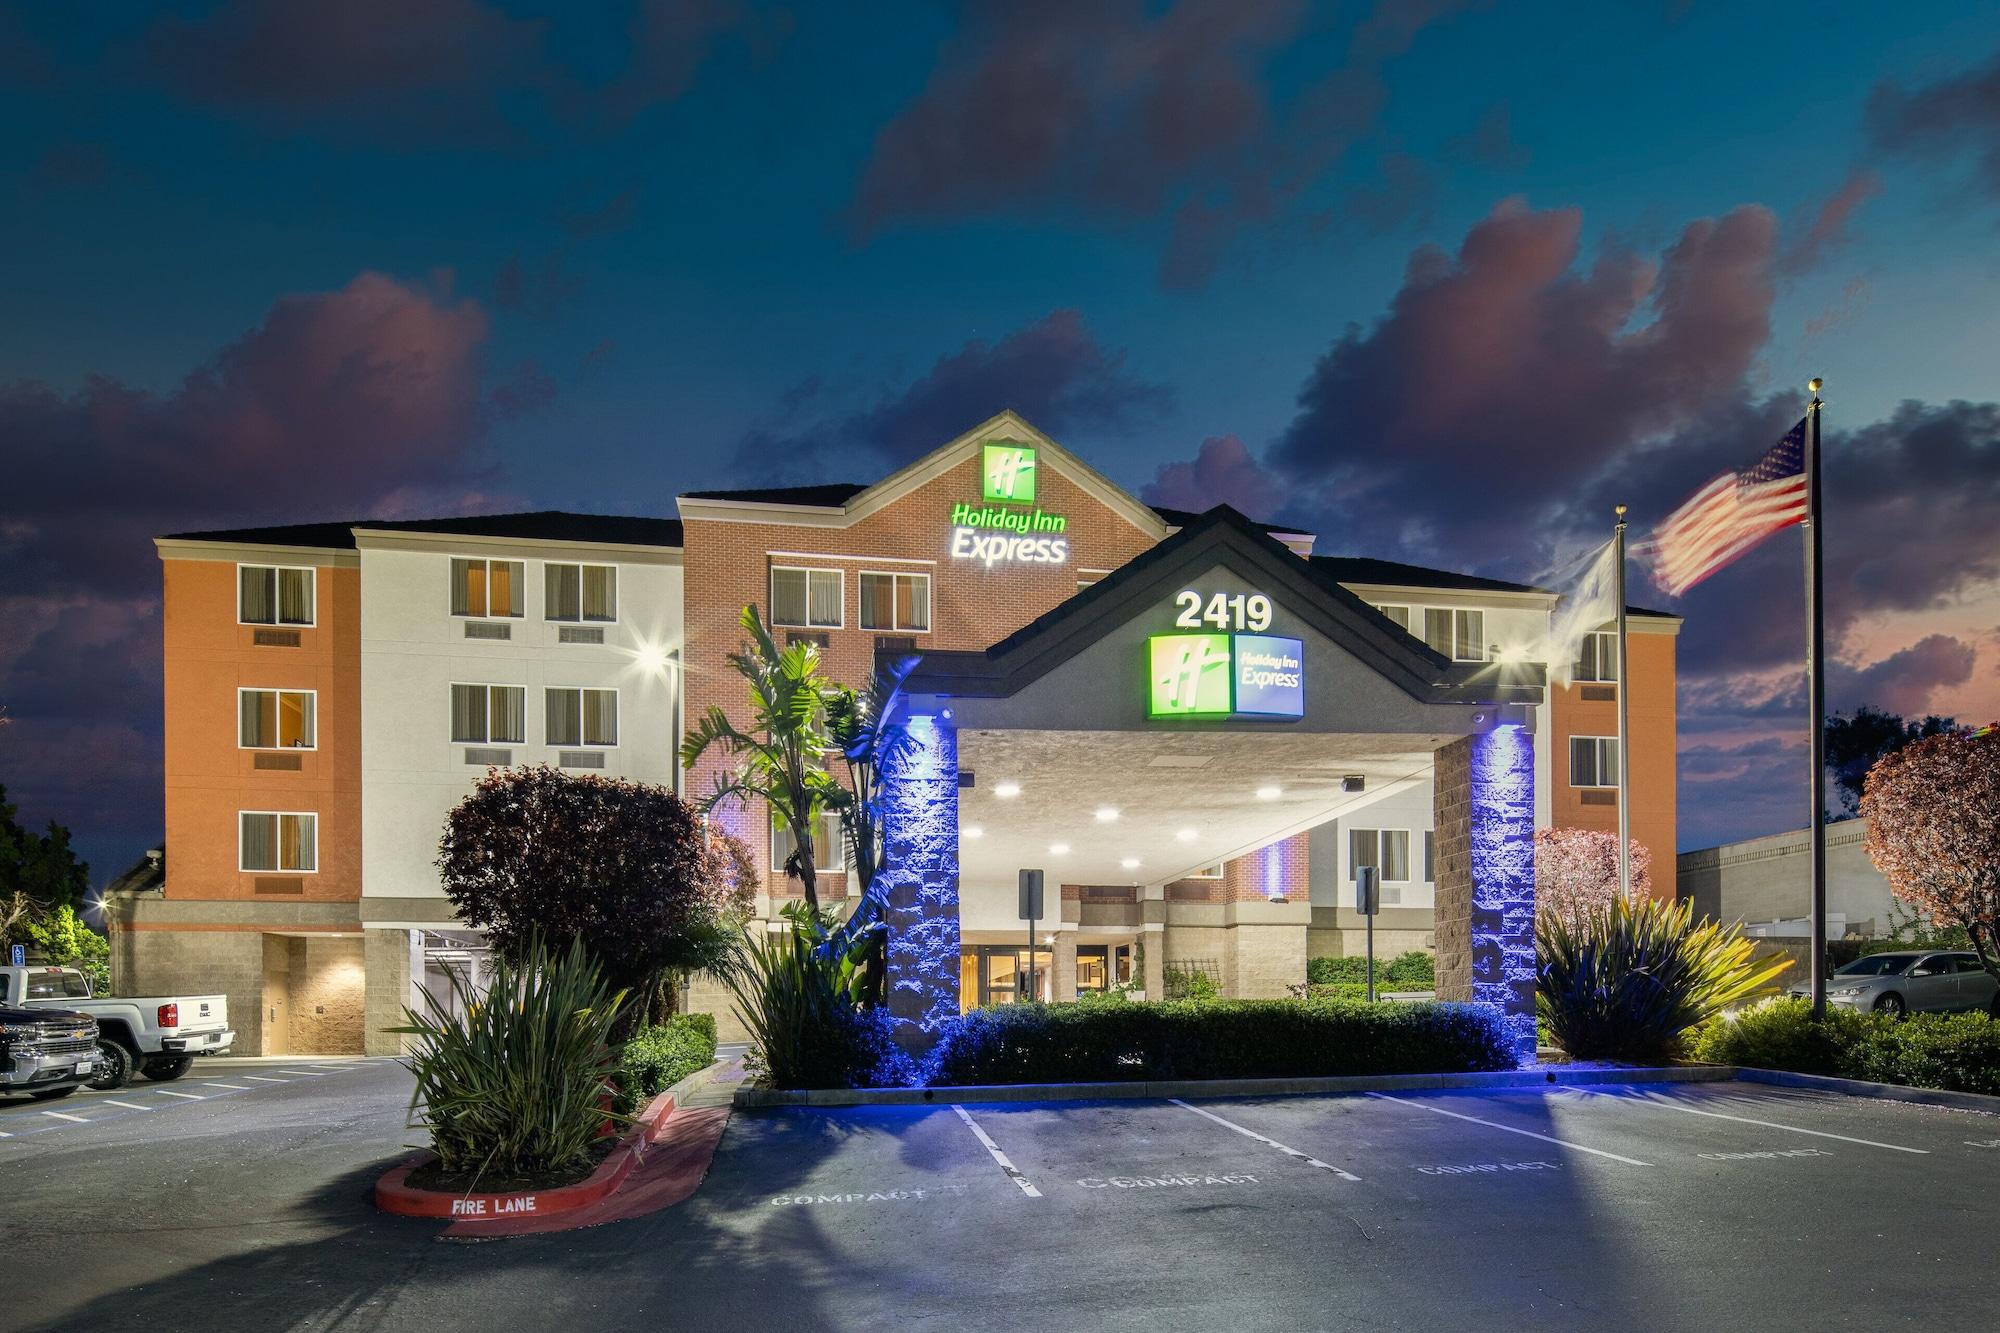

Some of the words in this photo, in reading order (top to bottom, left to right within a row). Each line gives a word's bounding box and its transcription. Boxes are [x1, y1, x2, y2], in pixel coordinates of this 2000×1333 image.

[951, 503, 1031, 534] Holiday
[1033, 509, 1066, 532] Inn
[951, 527, 1067, 567] Express
[1175, 590, 1273, 632] 2419
[1240, 652, 1282, 670] Holiday
[1282, 655, 1299, 669] Inn
[1241, 667, 1300, 690] Express
[1417, 1161, 1558, 1175] COMPACT
[452, 1199, 487, 1215] FIRE
[495, 1196, 536, 1213] LANE
[771, 1188, 927, 1206] COMPACT
